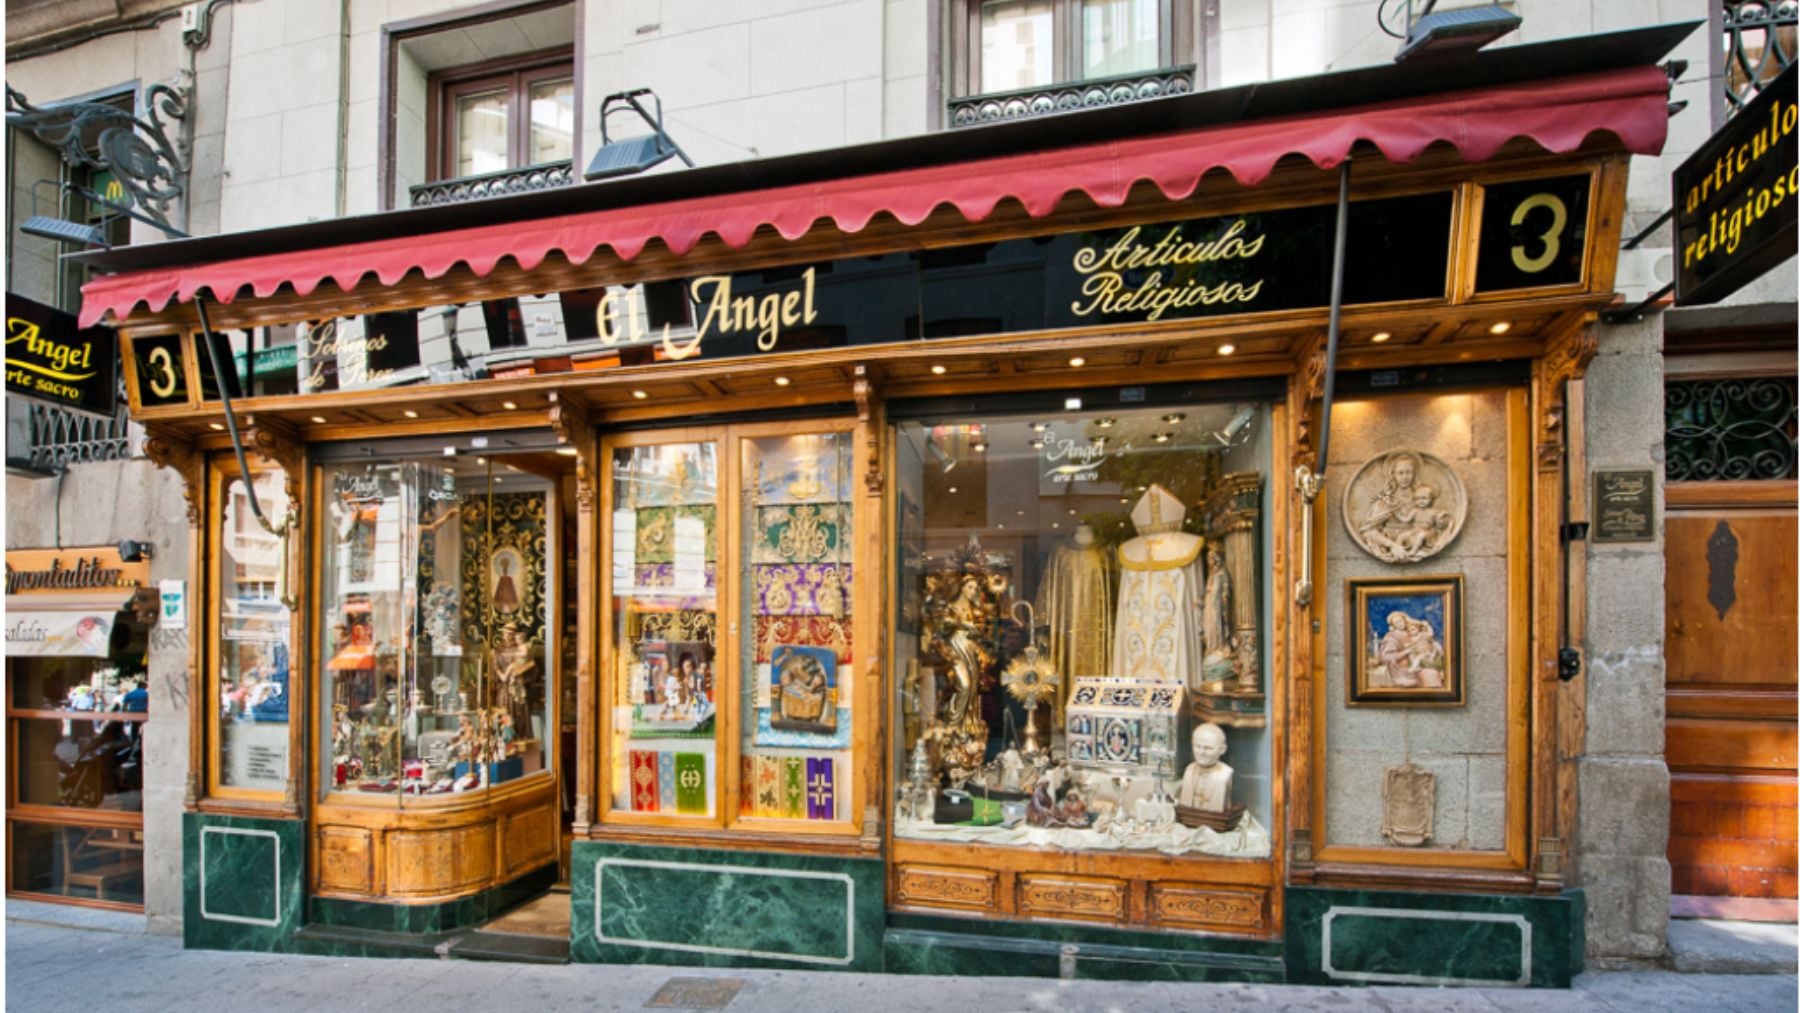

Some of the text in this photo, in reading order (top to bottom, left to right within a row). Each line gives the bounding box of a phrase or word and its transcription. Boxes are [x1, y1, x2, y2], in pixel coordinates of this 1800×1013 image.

[1073, 218, 1266, 273] Articulos
[1510, 192, 1568, 273] 3
[596, 266, 818, 360] El Angel
[1071, 271, 1264, 321] Religiosos
[6, 317, 92, 371] Angel
[303, 323, 388, 359] Sobrinos
[34, 379, 80, 399] sacro
[150, 346, 176, 398] 3
[1046, 436, 1105, 465] Angel
